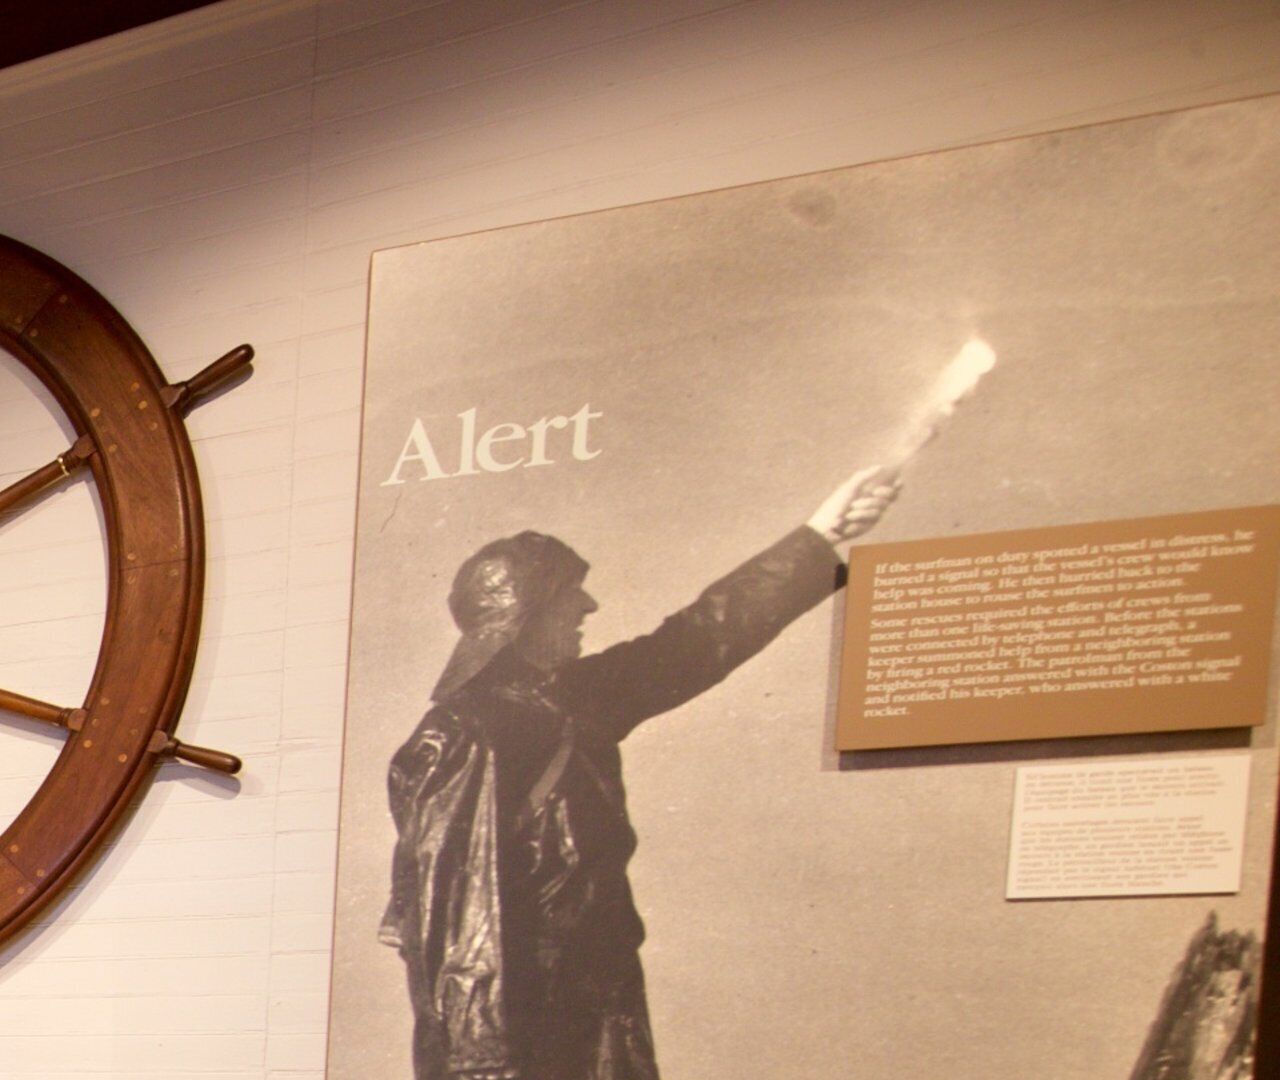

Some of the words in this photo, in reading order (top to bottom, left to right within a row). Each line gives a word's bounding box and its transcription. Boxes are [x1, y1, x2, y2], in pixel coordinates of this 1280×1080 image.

[380, 402, 604, 487] Alert
[873, 572, 926, 587] burned
[926, 573, 936, 582] a
[937, 567, 980, 583] signal
[981, 568, 1000, 577] so
[1000, 563, 1030, 575] that
[1032, 560, 1057, 572] the
[1115, 553, 1155, 565] crew
[1157, 546, 1209, 561] would
[1209, 544, 1255, 556] know
[875, 562, 887, 574] If
[888, 561, 912, 572] the
[913, 557, 972, 570] surfman
[973, 555, 995, 565] on
[996, 551, 1030, 563] duty
[1030, 544, 1089, 562] spotted
[1089, 545, 1100, 554] a
[1101, 538, 1147, 553] vessel
[1148, 537, 1167, 549] in
[1233, 529, 1255, 541] he
[871, 599, 918, 612] station
[919, 597, 963, 608] house
[964, 594, 981, 604] to
[982, 592, 1023, 603] rouse
[1024, 587, 1050, 599] the
[1051, 584, 1115, 597] surfmen
[1115, 582, 1134, 591] to
[1133, 577, 1187, 590] action.
[872, 587, 905, 600] help
[906, 587, 935, 596] was
[935, 581, 995, 594] coming.
[997, 577, 1019, 589] He
[1021, 575, 1056, 587] then
[1057, 568, 1116, 584] hurried
[1116, 565, 1154, 578] back
[1155, 565, 1174, 575] to
[1173, 562, 1201, 574] the
[868, 631, 906, 641] more
[907, 627, 940, 638] than
[941, 626, 969, 635] one
[1045, 614, 1101, 627] station.
[1103, 610, 1153, 622] Before
[1154, 606, 1181, 618] the
[1182, 603, 1244, 616] stations
[870, 618, 908, 629] Some
[909, 614, 964, 626] rescues
[964, 605, 1029, 623] required
[1029, 604, 1054, 616] the
[1056, 601, 1105, 613] efforts
[1106, 597, 1124, 609] of
[1125, 596, 1171, 608] crews
[1172, 592, 1212, 604] from
[867, 656, 915, 668] keeper
[916, 647, 997, 663] summoned
[997, 645, 1033, 658] help
[1033, 644, 1071, 654] from
[1072, 643, 1083, 651] a
[1084, 635, 1177, 651] neighboring
[1177, 630, 1232, 643] station
[868, 644, 903, 654] were
[904, 635, 980, 651] connected
[980, 634, 1000, 648] by
[1001, 630, 1075, 644] telephone
[1077, 626, 1107, 638] and
[1186, 621, 1197, 630] a
[865, 669, 884, 682] by
[885, 666, 924, 679] firing
[925, 667, 935, 675] a
[936, 662, 962, 674] red
[962, 660, 1013, 672] rocket.
[1018, 657, 1045, 668] The
[1047, 653, 1124, 669] patrolman
[1125, 650, 1164, 661] from
[1164, 646, 1191, 658] the
[865, 677, 950, 693] neighboring
[951, 674, 1001, 686] station
[1002, 667, 1073, 682] answered
[1074, 665, 1110, 677] with
[1110, 663, 1136, 675] the
[1194, 655, 1242, 671] signal
[863, 693, 891, 705] and
[891, 689, 947, 703] notified
[948, 688, 971, 699] his
[1028, 682, 1062, 694] who
[1063, 676, 1136, 691] answered
[1136, 674, 1174, 686] with
[1174, 676, 1185, 684] a
[1186, 671, 1232, 683] white
[862, 706, 910, 718] rocket.
